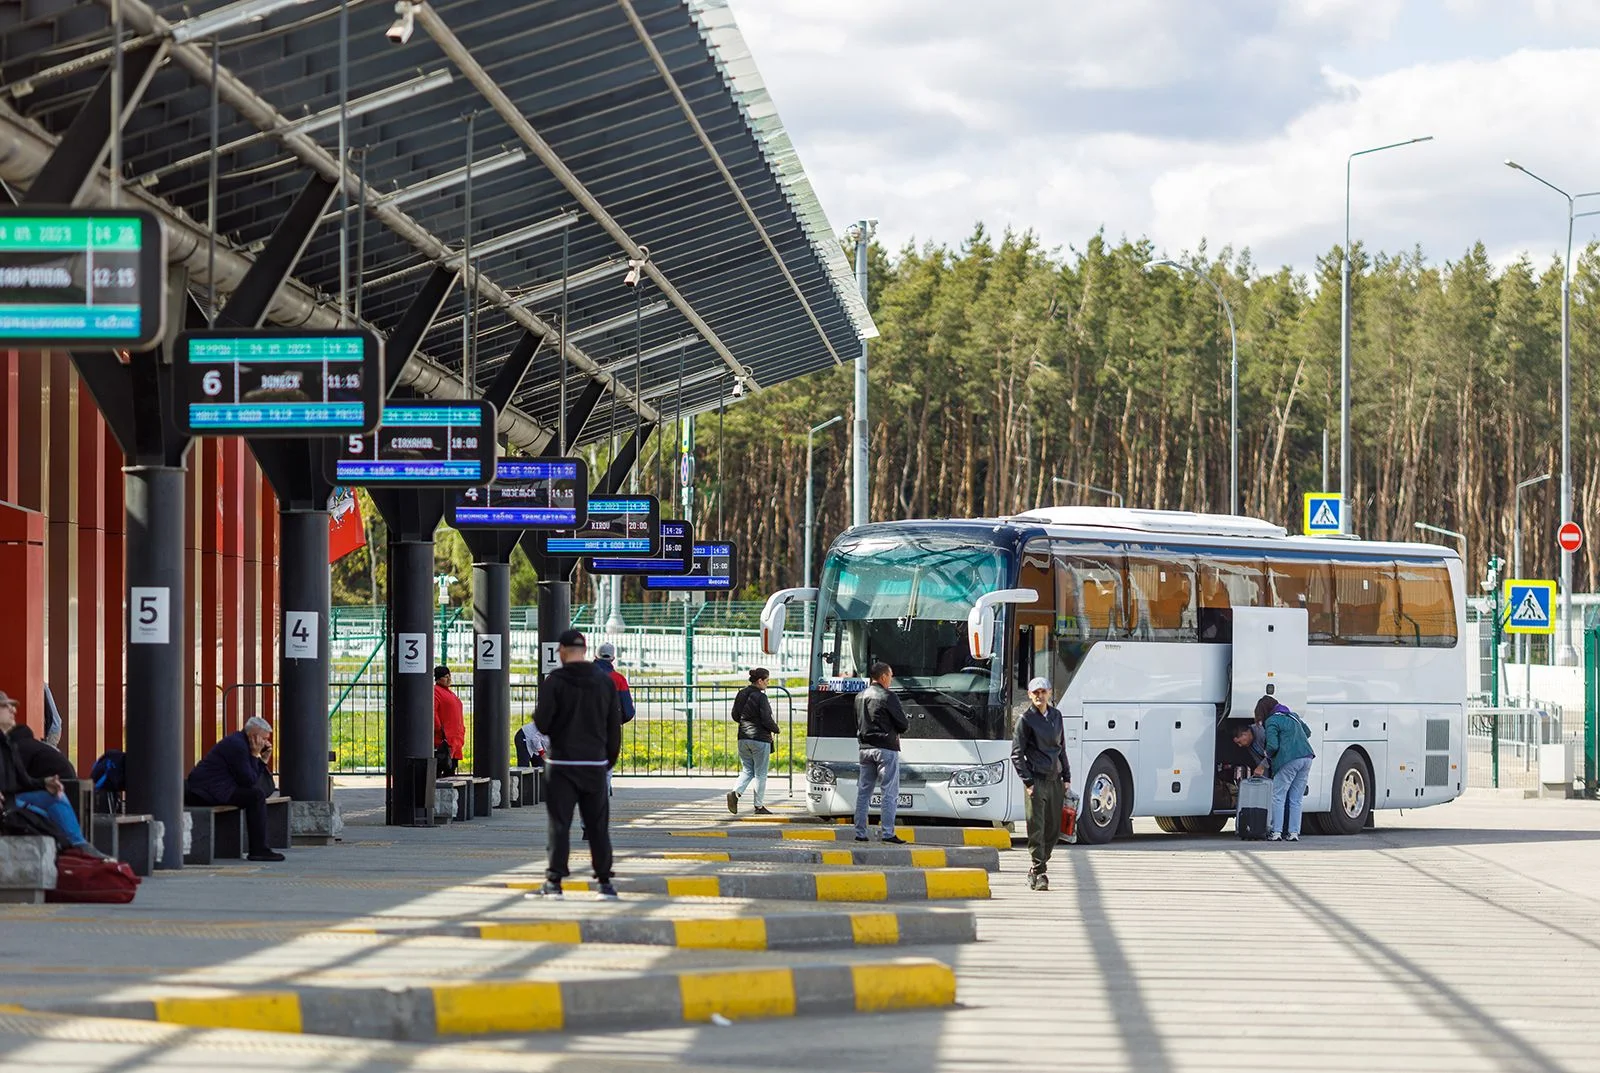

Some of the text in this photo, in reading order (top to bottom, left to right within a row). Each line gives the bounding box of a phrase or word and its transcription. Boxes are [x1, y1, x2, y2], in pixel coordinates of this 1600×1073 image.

[202, 370, 223, 396] 6
[348, 434, 364, 453] 5
[628, 521, 648, 530] 20:00
[138, 596, 159, 625] 5
[291, 619, 310, 643] 4
[404, 639, 419, 660] 3
[481, 639, 495, 658] 2
[547, 647, 557, 664] 1
